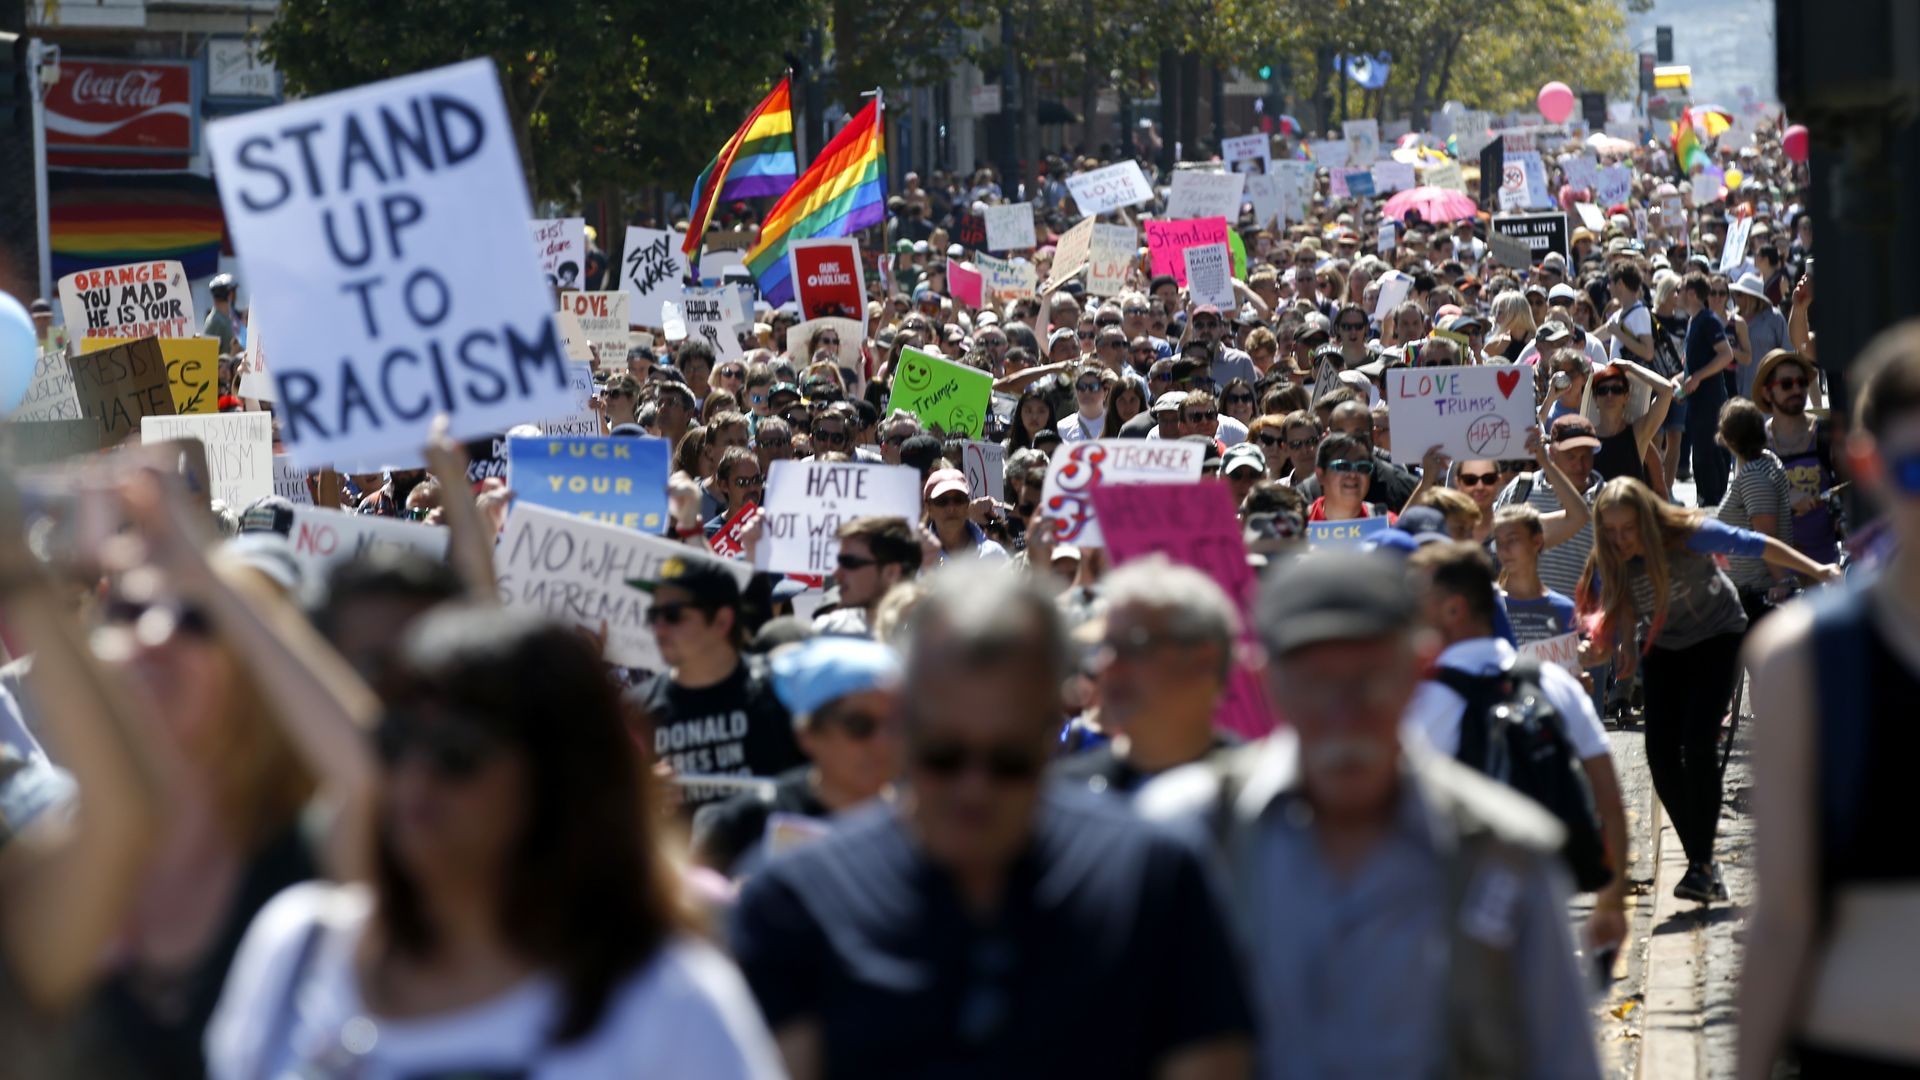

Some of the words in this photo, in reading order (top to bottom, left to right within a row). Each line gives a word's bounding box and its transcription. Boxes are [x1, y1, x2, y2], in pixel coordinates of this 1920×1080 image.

[72, 67, 162, 106] Coca-Cola
[236, 92, 487, 213] STAND
[1082, 175, 1134, 199] LOVE
[323, 193, 423, 269] UP
[1149, 224, 1200, 248] Stand
[1203, 229, 1225, 243] up
[1501, 225, 1528, 235] BLACK
[1533, 222, 1557, 233] LIVES
[626, 234, 670, 279] STAY
[819, 262, 840, 273] GUNS
[1190, 254, 1223, 266] RACISM
[74, 263, 167, 291] ORANGE
[633, 257, 680, 296] WOKE
[817, 273, 851, 286] VIOLENCE
[77, 287, 111, 310] YOU
[120, 281, 167, 306] MAD
[339, 269, 451, 339] TO
[86, 307, 110, 328] HE
[117, 305, 136, 325] IS
[140, 299, 184, 321] YOUR
[78, 342, 157, 391] RESIST
[275, 313, 571, 443] RACISM
[912, 378, 959, 414] Trumps
[1400, 373, 1462, 399] LOVE
[87, 384, 165, 433] HATE
[1434, 396, 1496, 416] TRUMPS
[154, 419, 197, 441] THIS
[203, 420, 219, 441] IS
[222, 415, 266, 442] WHAT
[1469, 419, 1511, 443] HATE
[548, 442, 631, 460] FUCK
[548, 475, 633, 495] YOUR
[806, 466, 869, 500] HATE
[296, 522, 339, 556] NO
[764, 513, 800, 539] NOT
[509, 521, 575, 572] NO
[582, 538, 662, 584] WHIT
[809, 540, 837, 571] HE
[498, 574, 649, 627] SUPREMA
[654, 710, 749, 754] DONALD
[715, 741, 744, 768] UN
